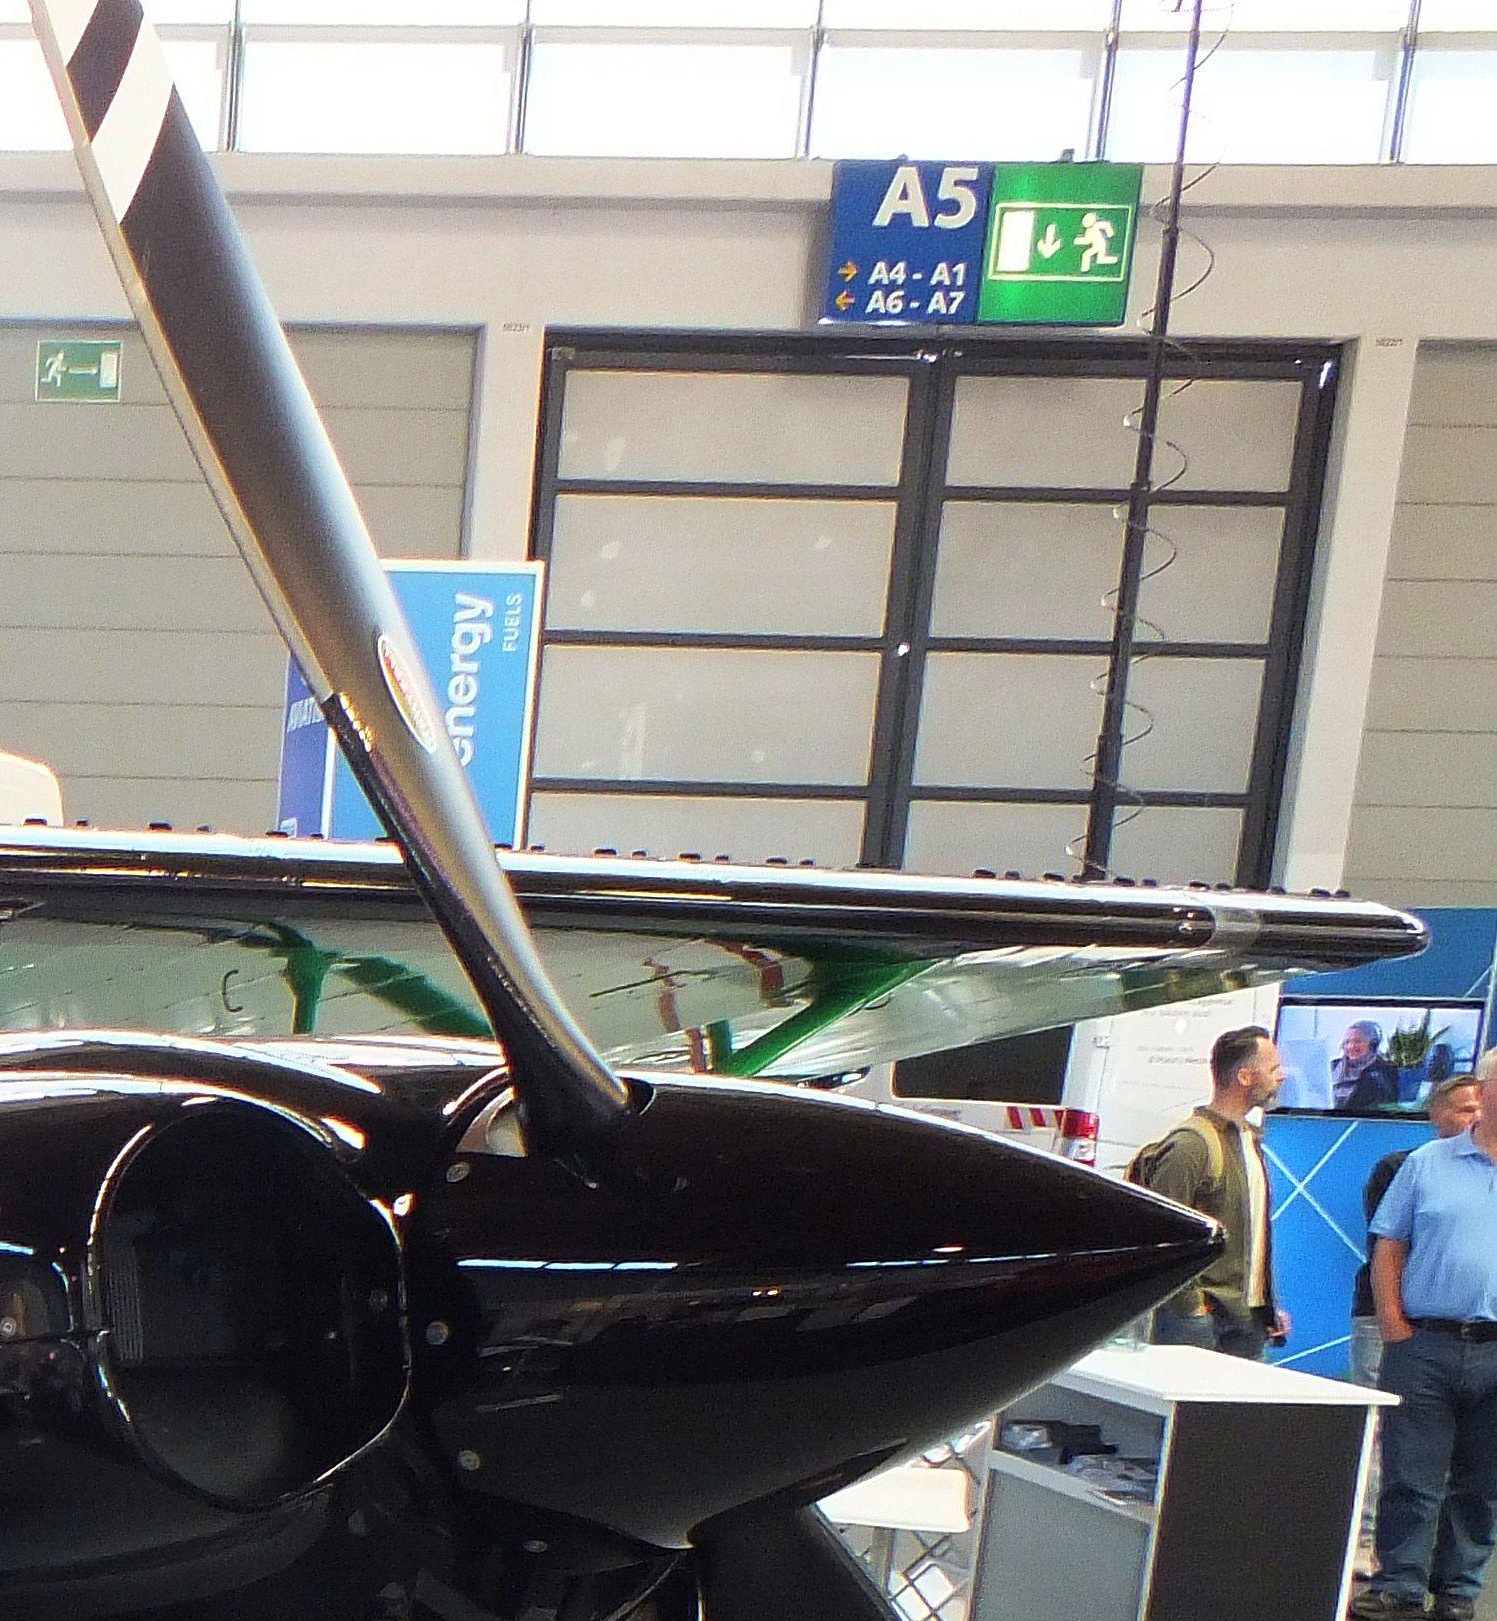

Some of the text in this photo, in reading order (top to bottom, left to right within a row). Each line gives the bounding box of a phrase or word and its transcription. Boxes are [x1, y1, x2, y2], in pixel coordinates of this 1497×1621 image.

[872, 166, 979, 229] A5
[867, 261, 907, 285] A4
[929, 262, 967, 286] A1
[864, 290, 905, 314] A6
[926, 291, 966, 315] A7
[502, 592, 523, 653] FUELS
